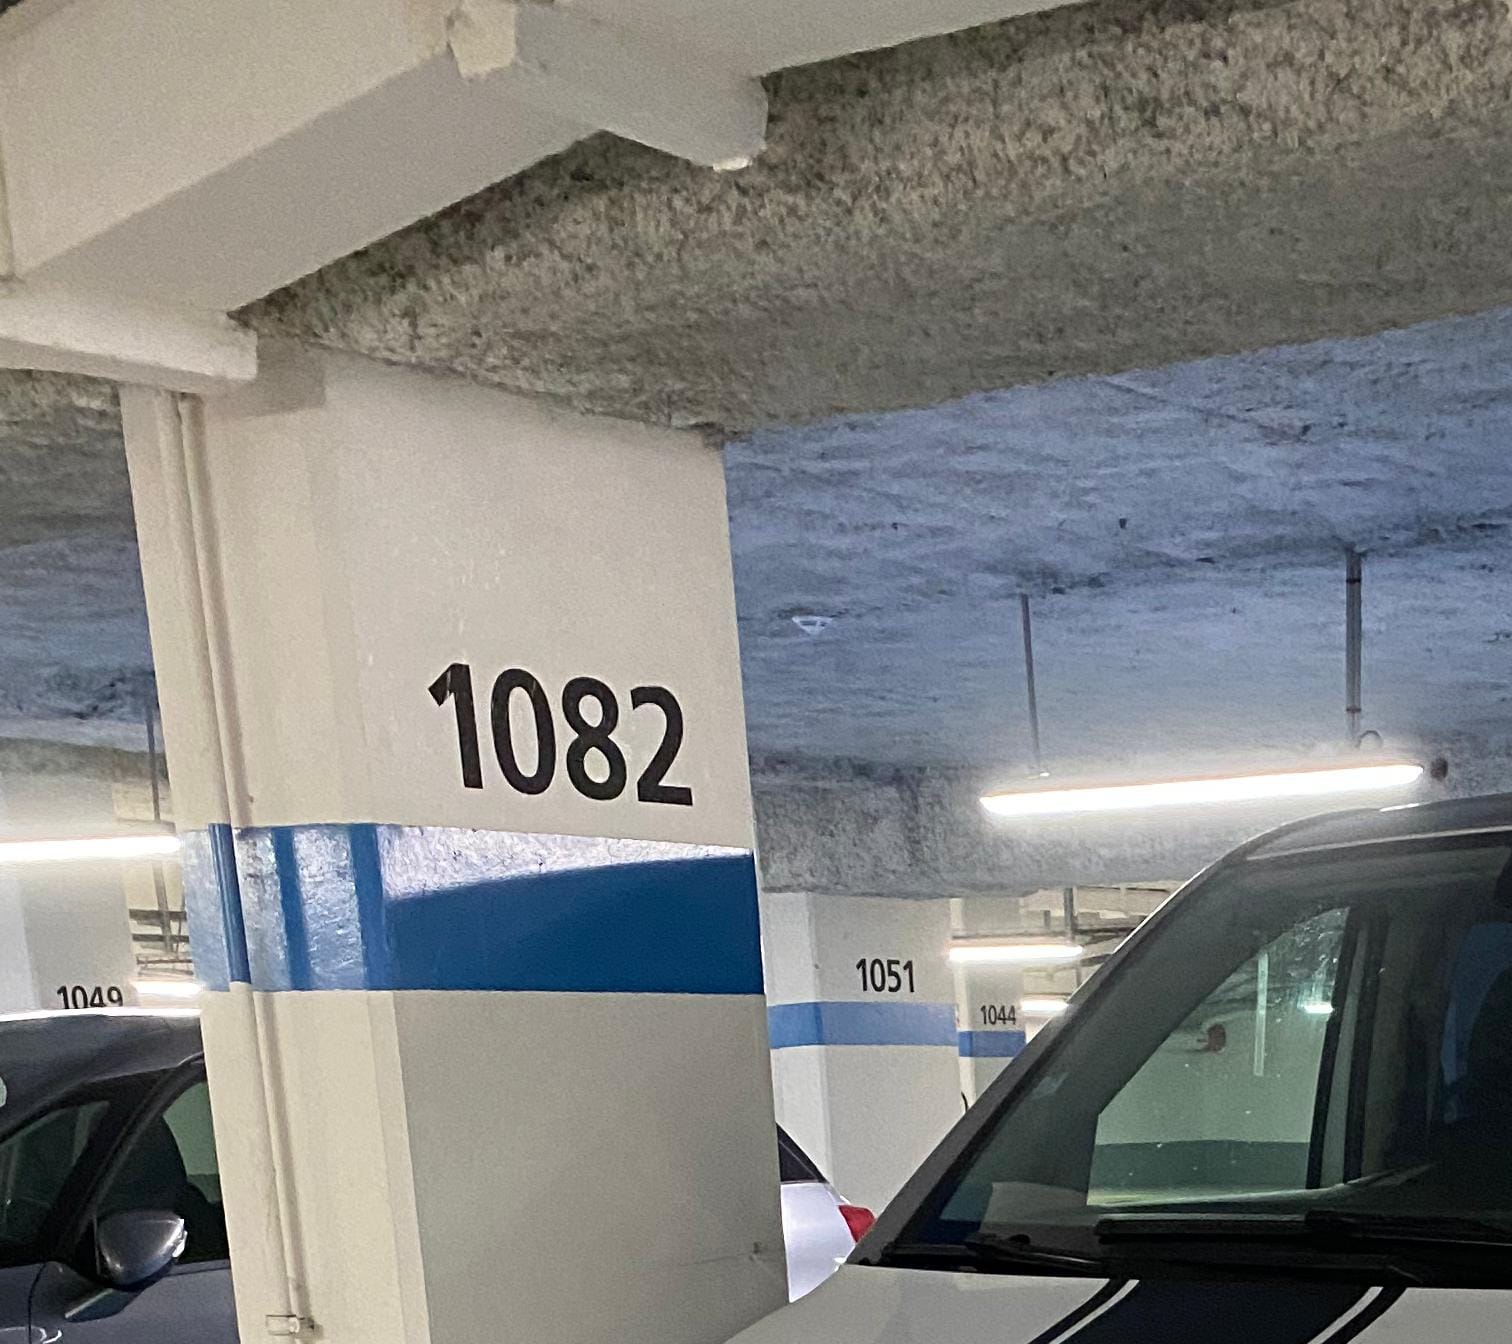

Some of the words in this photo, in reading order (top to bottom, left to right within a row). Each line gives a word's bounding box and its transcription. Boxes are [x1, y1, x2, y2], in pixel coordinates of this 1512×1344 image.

[428, 663, 694, 806] 1082
[856, 958, 915, 993] 1051
[56, 985, 124, 1009] 1049
[980, 1005, 1016, 1025] 1044
